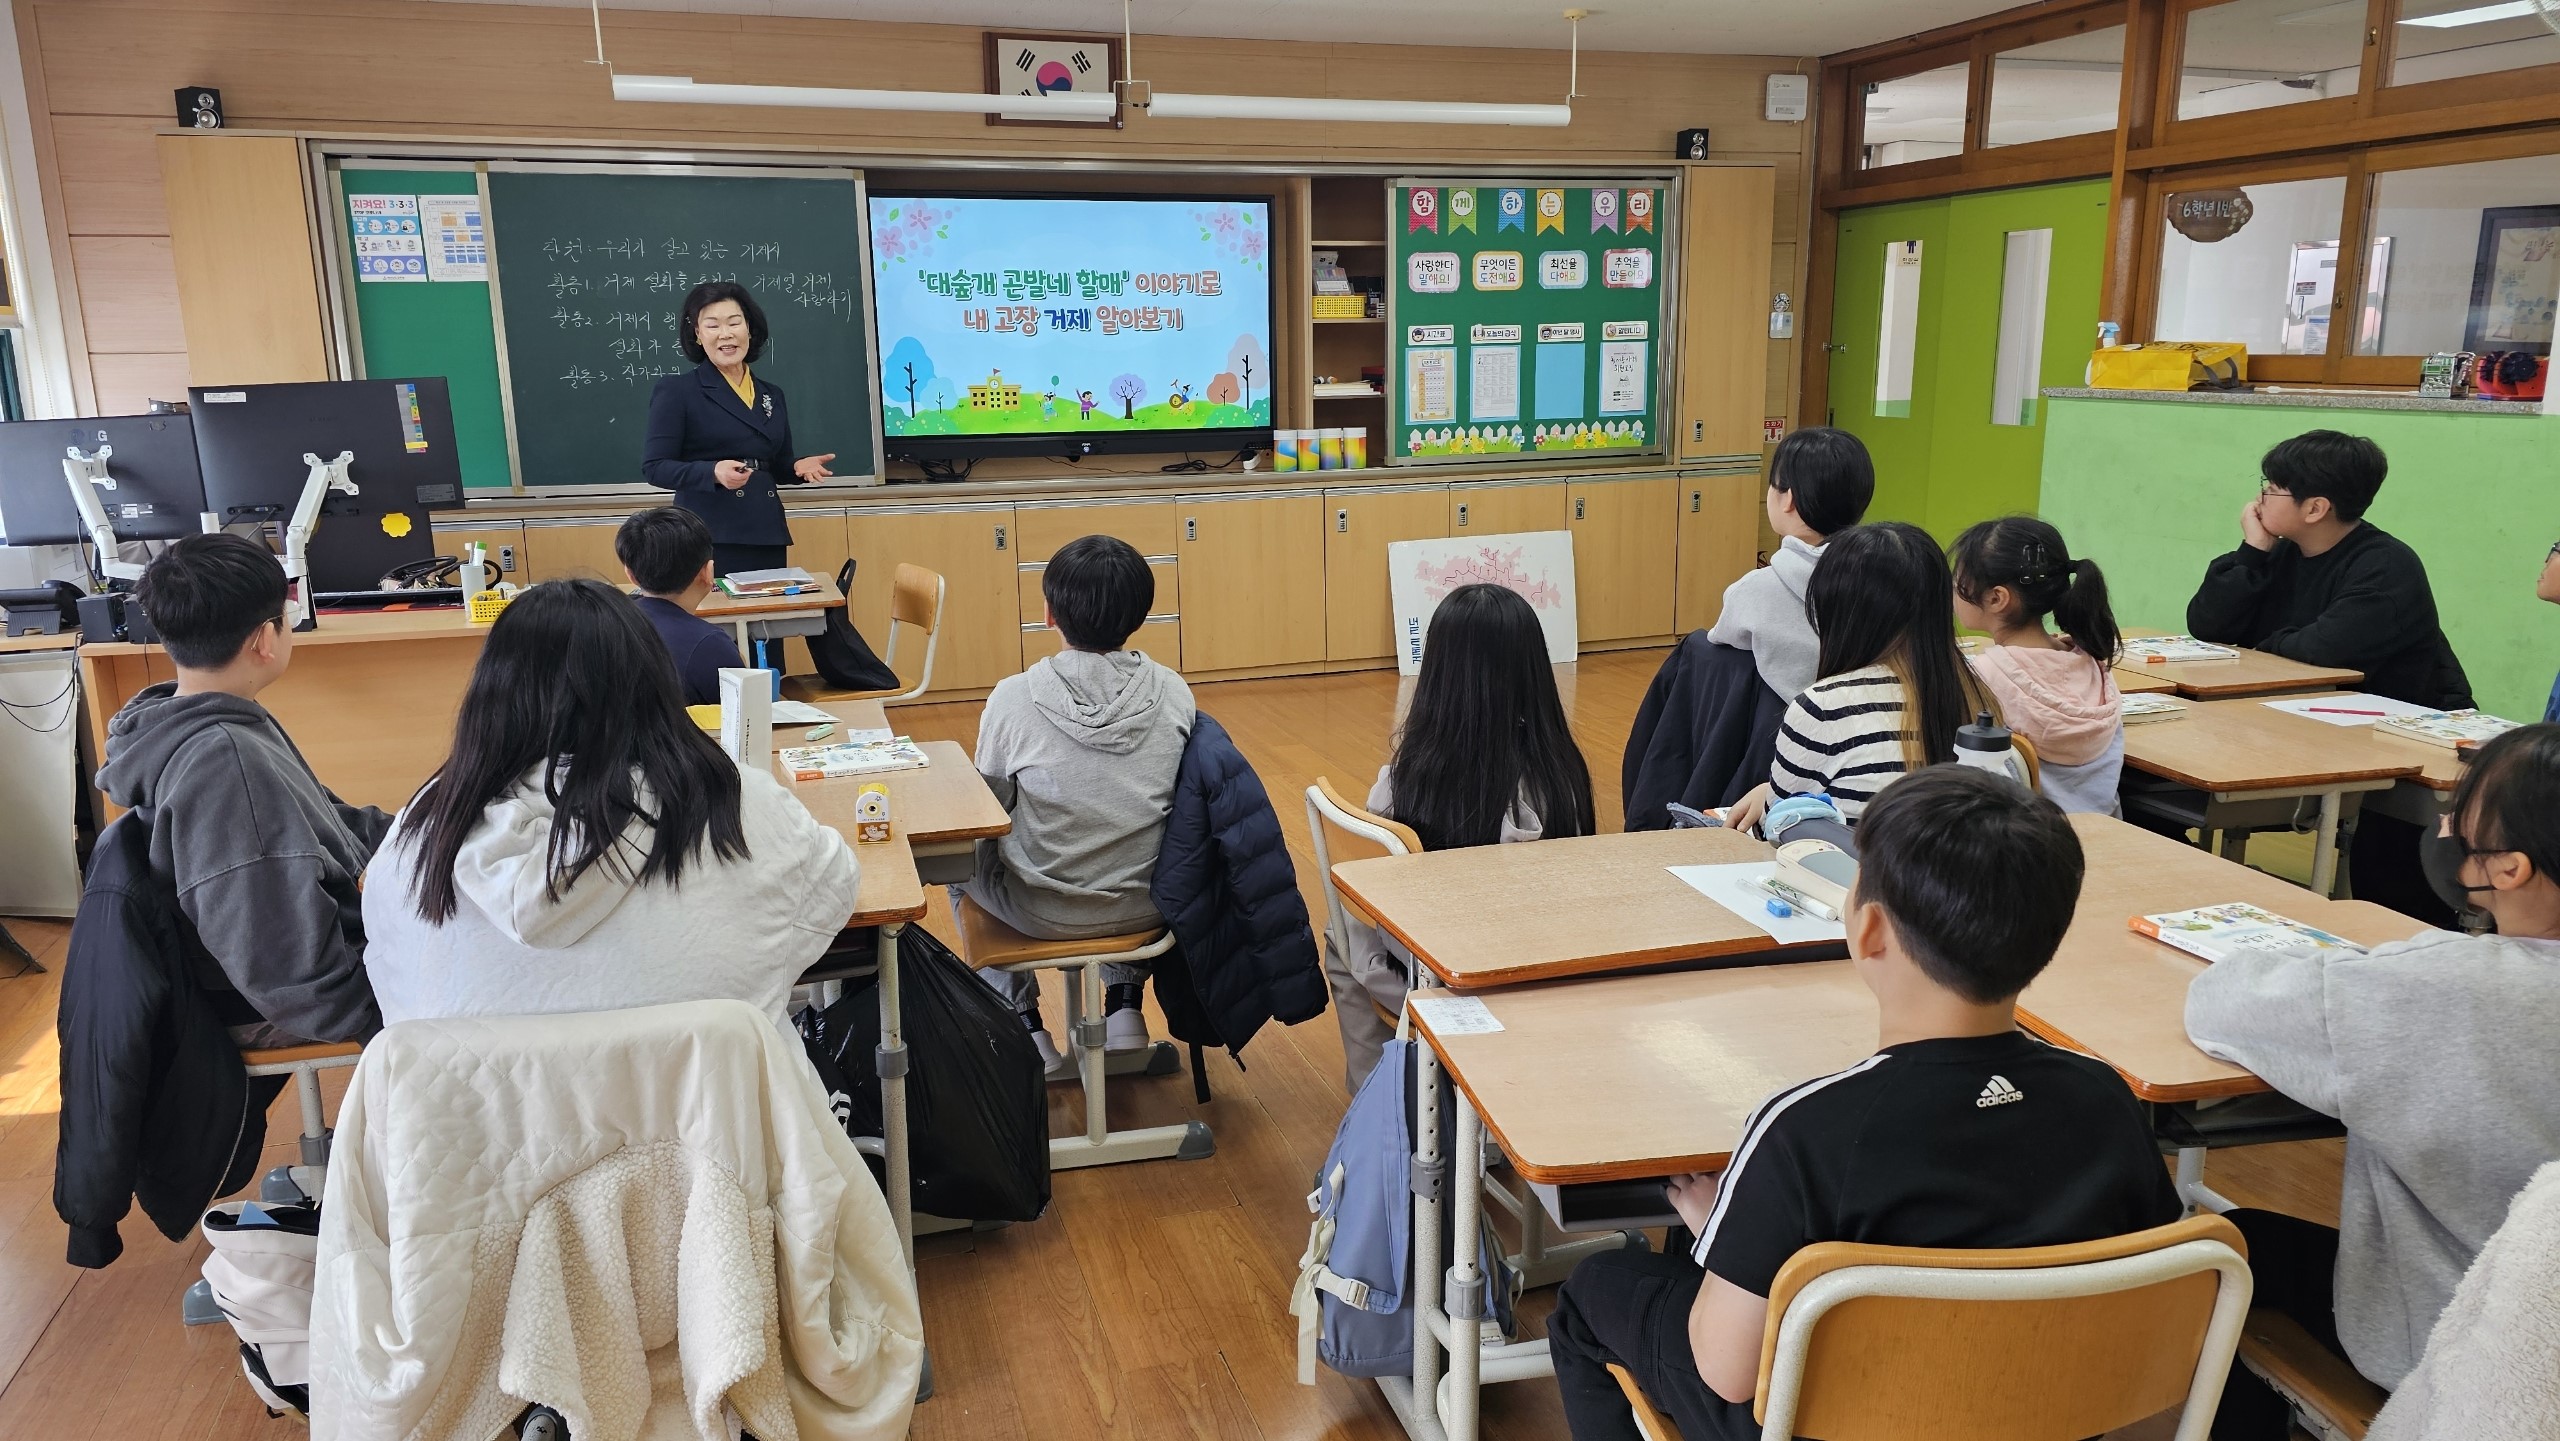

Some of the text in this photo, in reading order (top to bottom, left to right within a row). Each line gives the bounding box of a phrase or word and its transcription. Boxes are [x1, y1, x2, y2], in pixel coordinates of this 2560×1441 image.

[352, 200, 386, 209] 지켜요!
[1416, 195, 1646, 214] 함께 하는 우리
[596, 237, 646, 260] 우리가
[661, 236, 690, 262] 살고
[700, 239, 729, 261] 있는
[1415, 256, 1641, 272] 사랑한다 무엇이든 최선을 추억을
[1002, 269, 1071, 300] 곤발네
[1075, 269, 1129, 300] 할매'
[1135, 270, 1222, 296] 이야기로
[1418, 269, 1645, 286] 말해요! 도전해요 다해요 만들어요
[793, 288, 852, 323] 사랑하기
[605, 311, 651, 332] 거제시
[963, 305, 1184, 336] 내 고장 거제 알아보기
[1486, 330, 1516, 338] 오늘의 급식
[1410, 637, 1422, 665] 거제시
[1976, 1090, 2024, 1108] adidas
